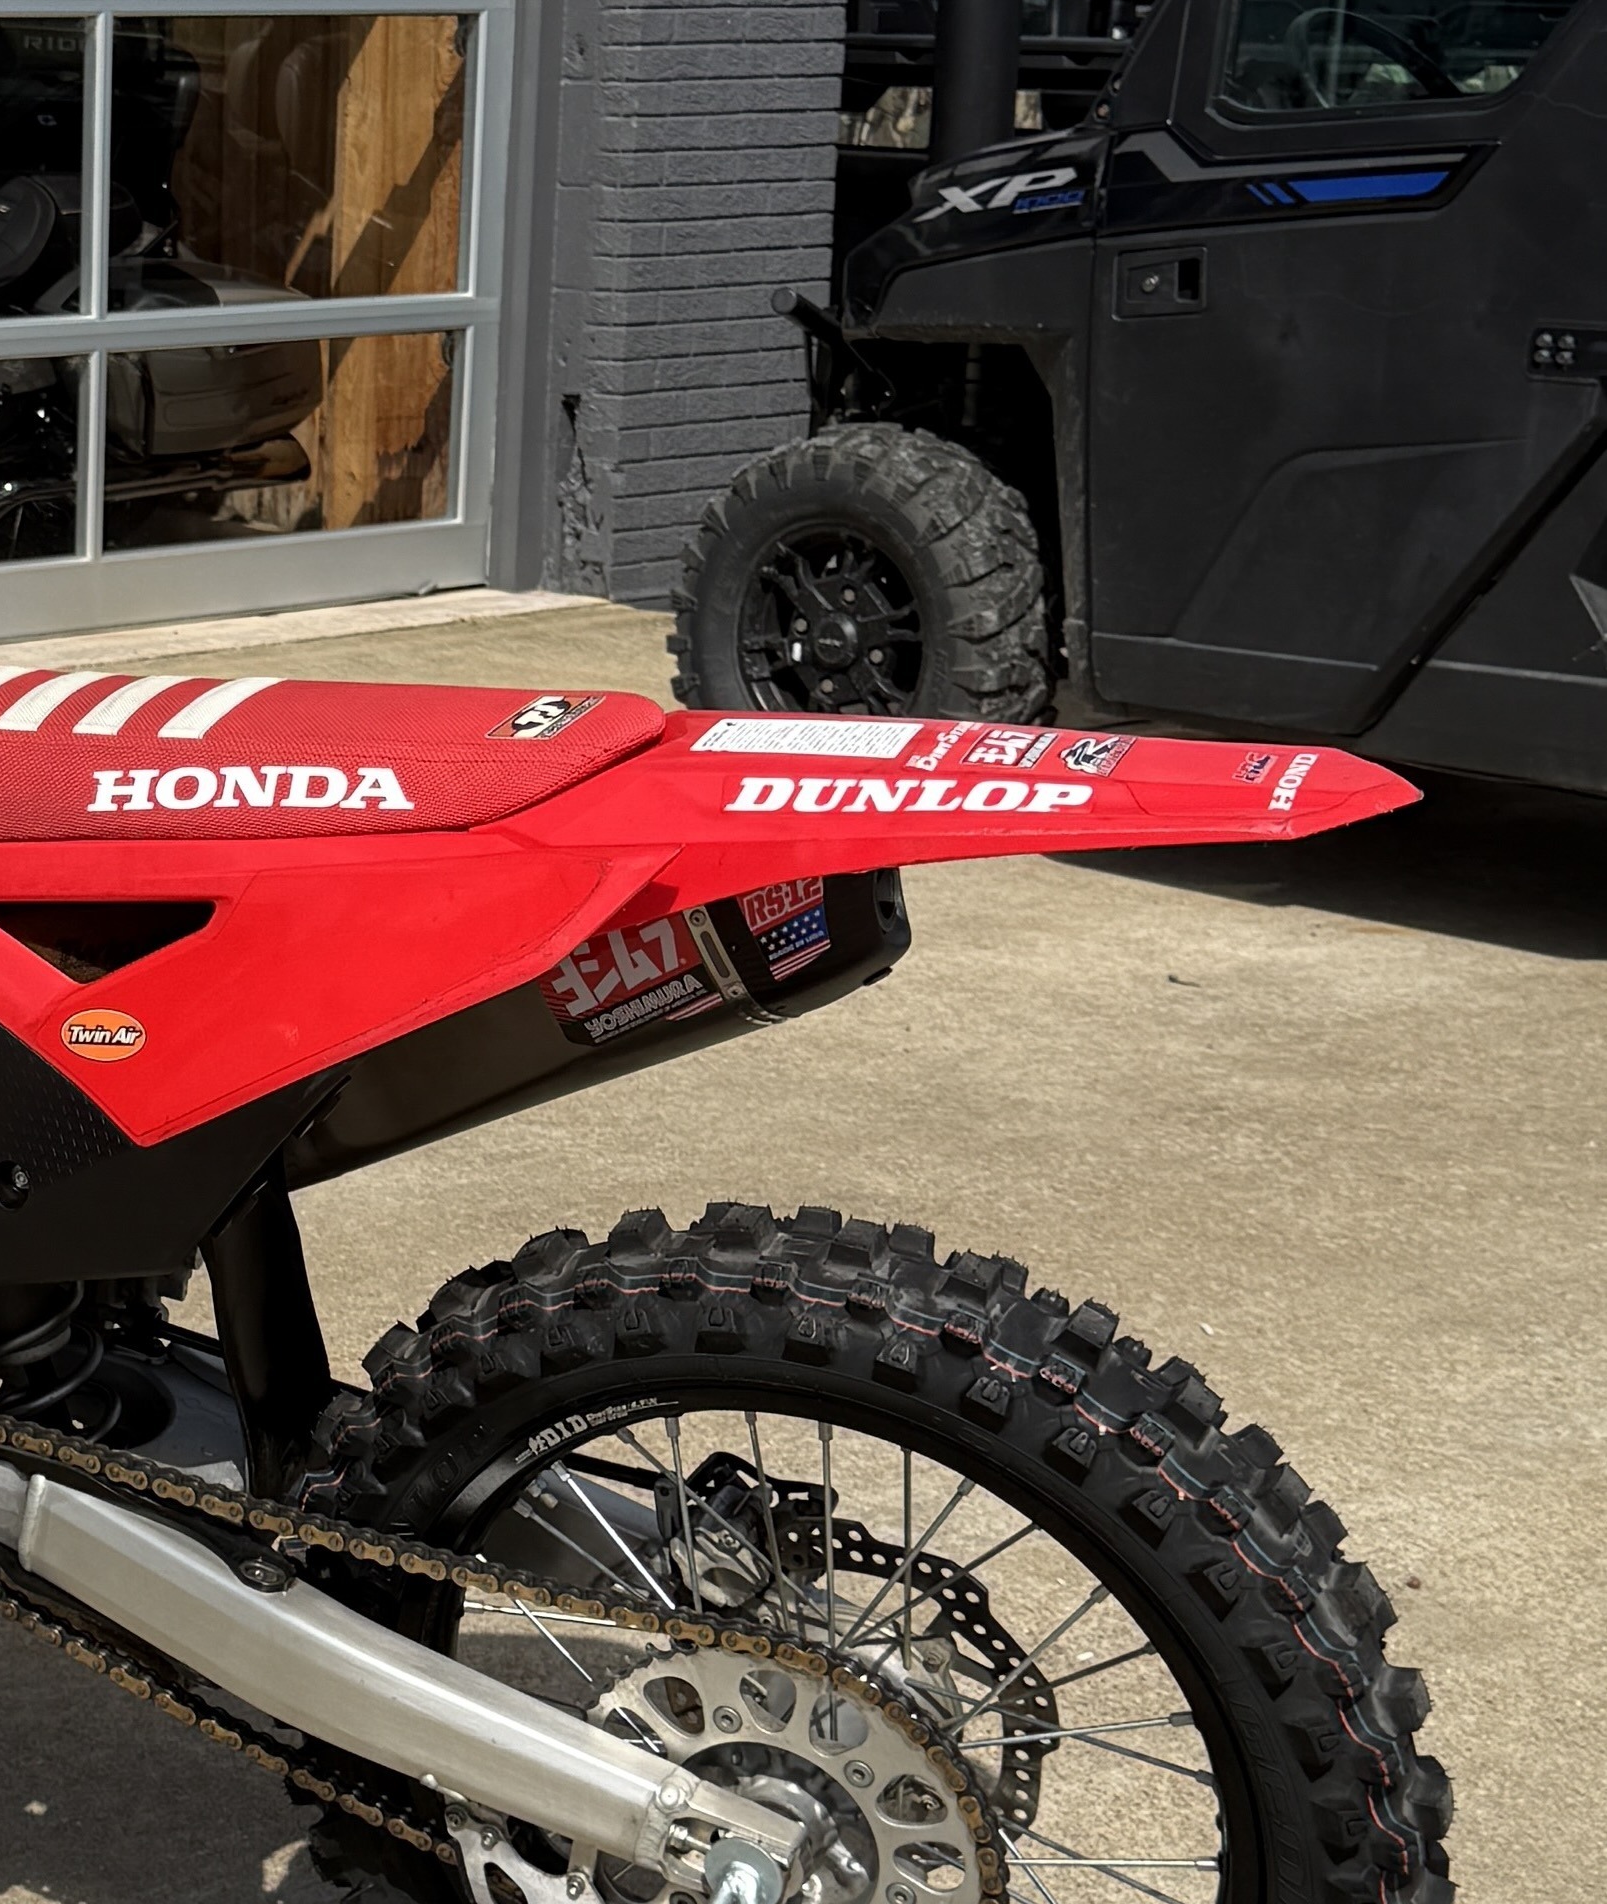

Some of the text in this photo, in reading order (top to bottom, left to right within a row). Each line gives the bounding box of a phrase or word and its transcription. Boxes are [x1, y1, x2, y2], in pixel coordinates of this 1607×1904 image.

[23, 34, 85, 52] RID
[912, 166, 1078, 223] XP
[86, 766, 415, 812] HONDA
[723, 777, 1093, 813] DUNLOP
[1268, 753, 1319, 811] HOND
[583, 973, 705, 1039] YOSHIMURA
[69, 1025, 142, 1045] Twin Air
